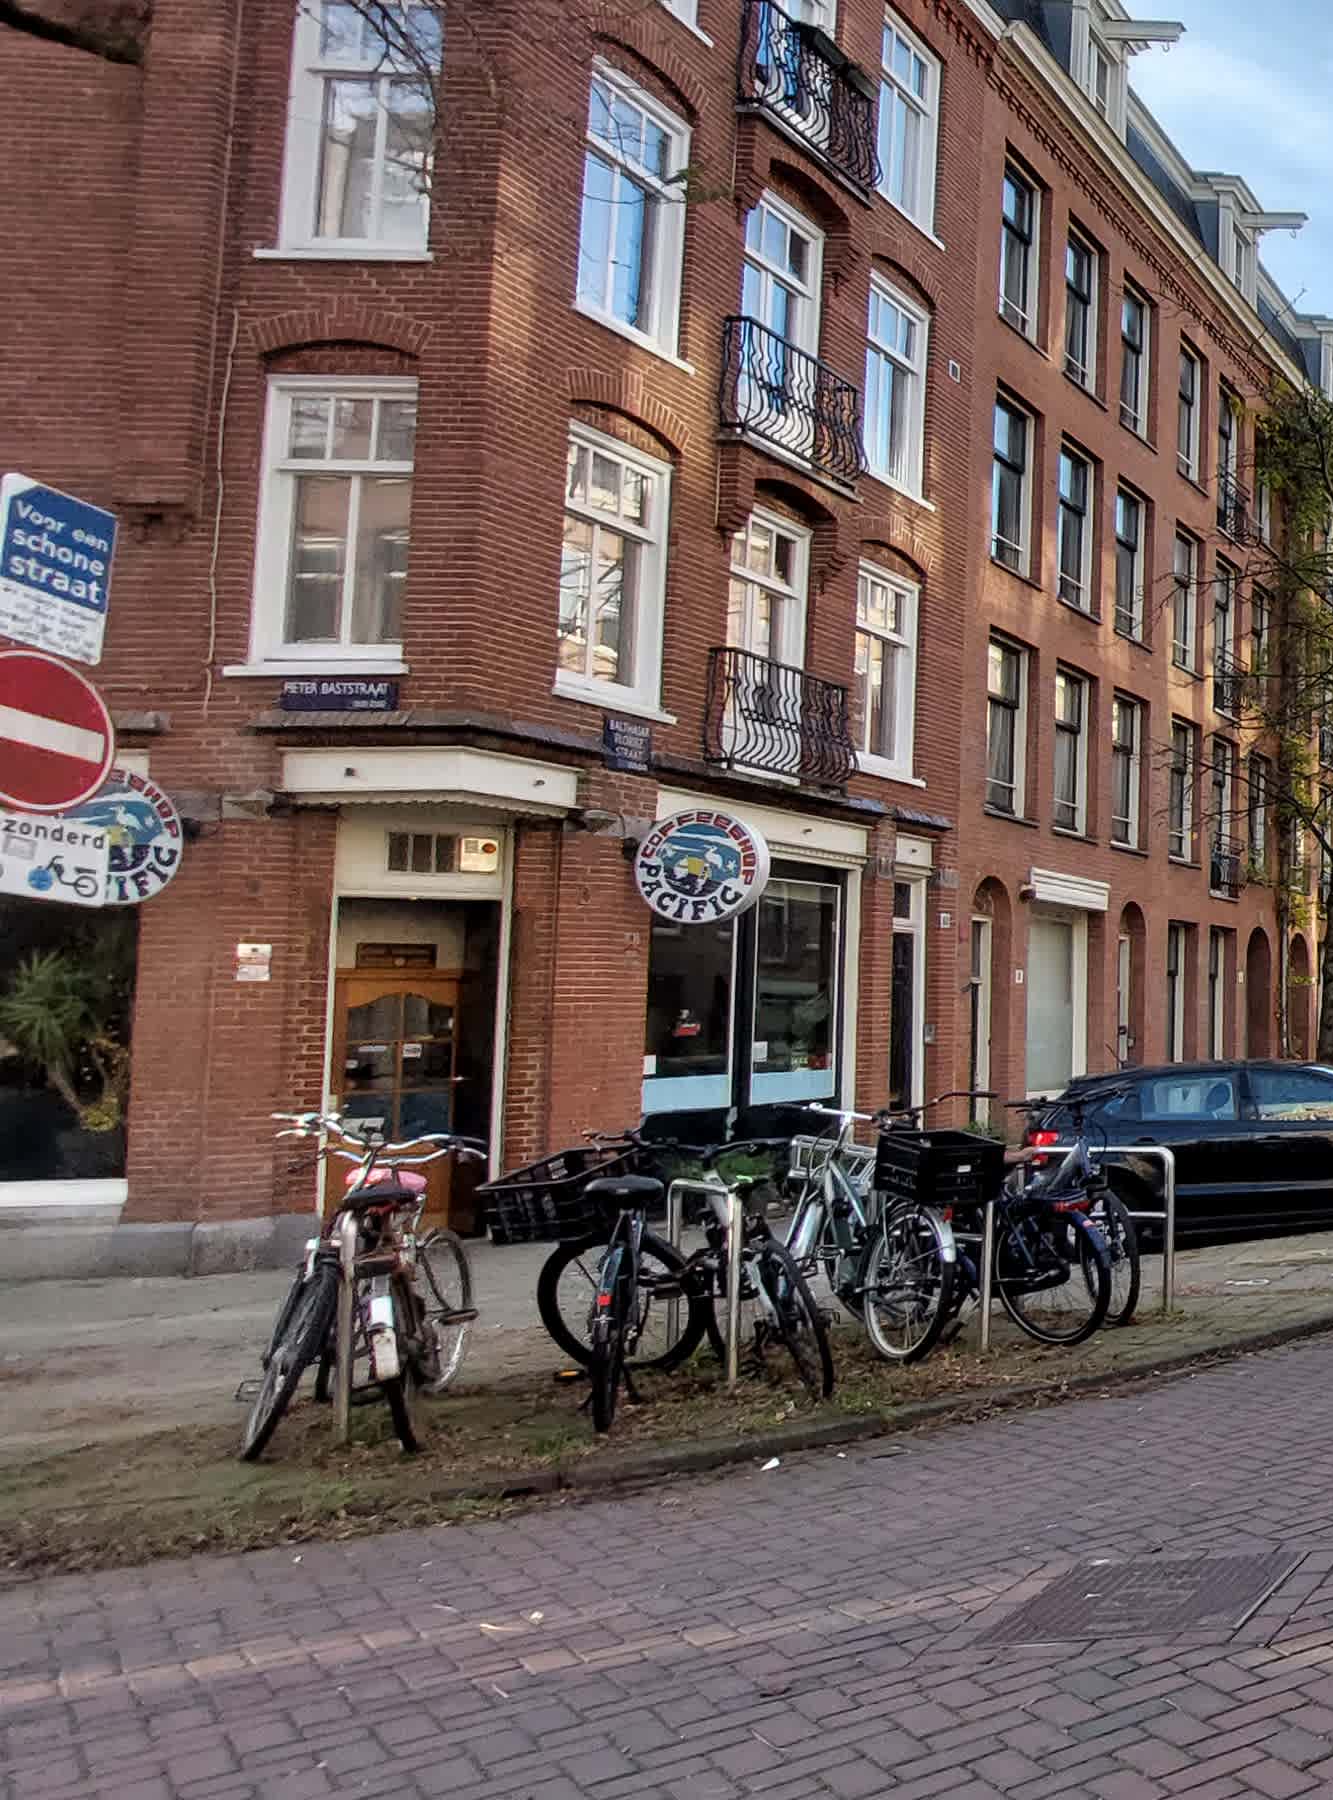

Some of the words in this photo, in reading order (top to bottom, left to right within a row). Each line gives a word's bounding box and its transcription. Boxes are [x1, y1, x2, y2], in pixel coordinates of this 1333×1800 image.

[16, 499, 67, 534] Voor
[71, 527, 109, 552] een
[11, 527, 105, 577] schone
[9, 554, 103, 604] straat
[284, 681, 318, 695] PIETER
[320, 682, 389, 697] BASTSTRAAT
[2, 818, 105, 850] zonderd
[640, 811, 757, 886] COFFEESHOP
[639, 859, 743, 921] PACIFIC
